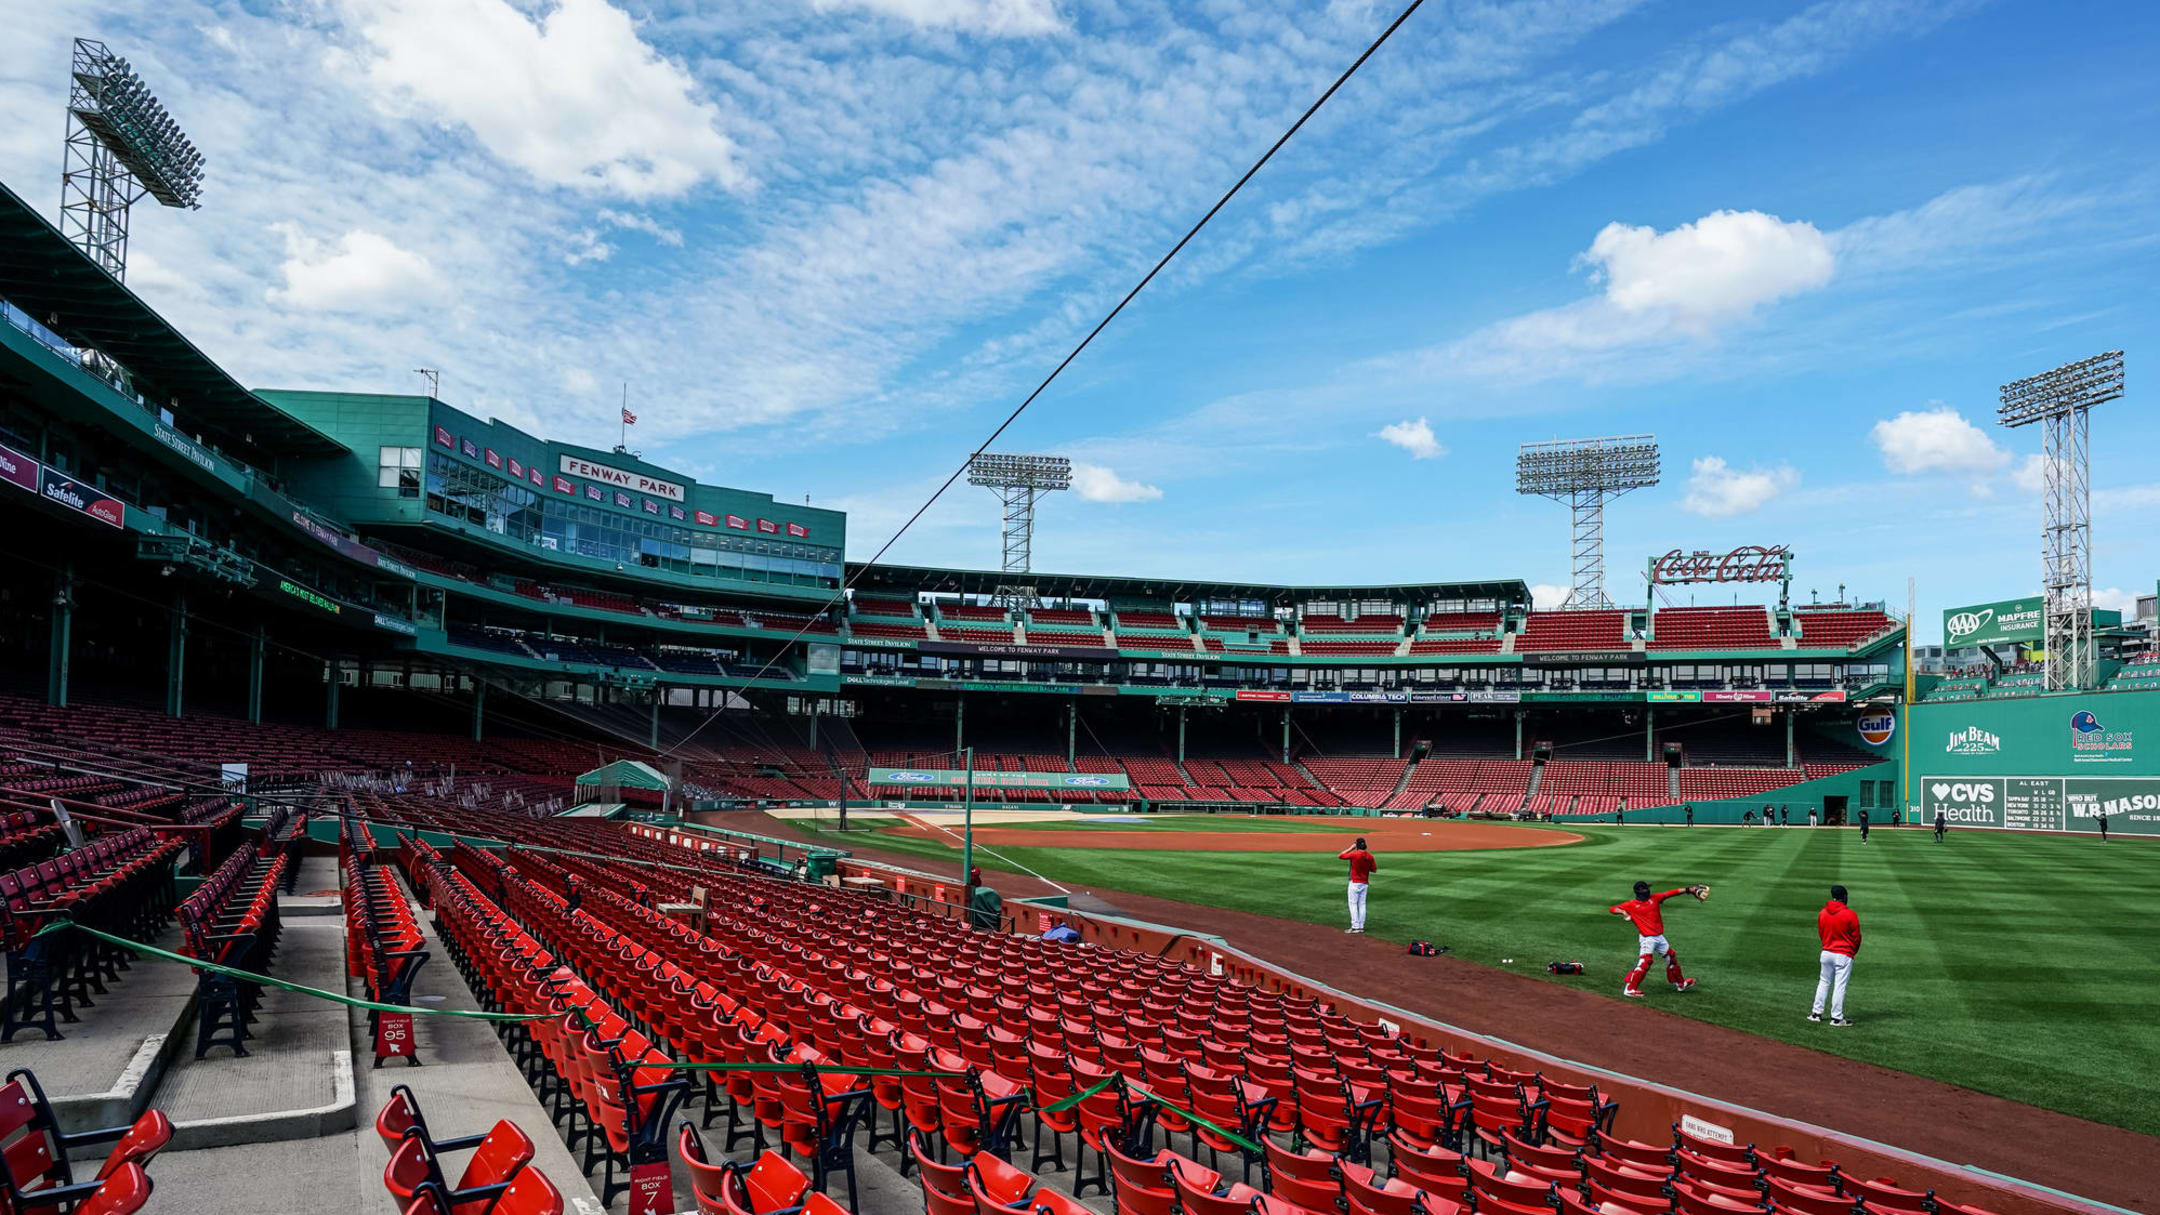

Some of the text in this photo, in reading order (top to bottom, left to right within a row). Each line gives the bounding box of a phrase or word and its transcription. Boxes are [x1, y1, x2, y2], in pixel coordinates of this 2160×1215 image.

[569, 461, 630, 485] FENWAY
[639, 479, 676, 497] PARK
[47, 483, 84, 509] Safelite
[92, 505, 117, 522] AutoGlass
[1653, 544, 1790, 585] Coca-Cola
[1951, 613, 1978, 634] AAA
[1998, 610, 2041, 622] MAPFRE
[2000, 621, 2038, 631] INSURANCE
[1860, 717, 1892, 731] Gulf
[1946, 726, 2000, 752] JIM BEAM
[2078, 732, 2132, 742] RED SOX
[1963, 743, 1984, 751] 225
[2077, 742, 2132, 750] SCHOLARS
[1951, 783, 1994, 803] CVS
[1933, 803, 1995, 822] Health
[2103, 794, 2160, 816] MASO
[384, 1030, 406, 1041] 95
[641, 1182, 660, 1190] BOX
[645, 1191, 658, 1205] 7
